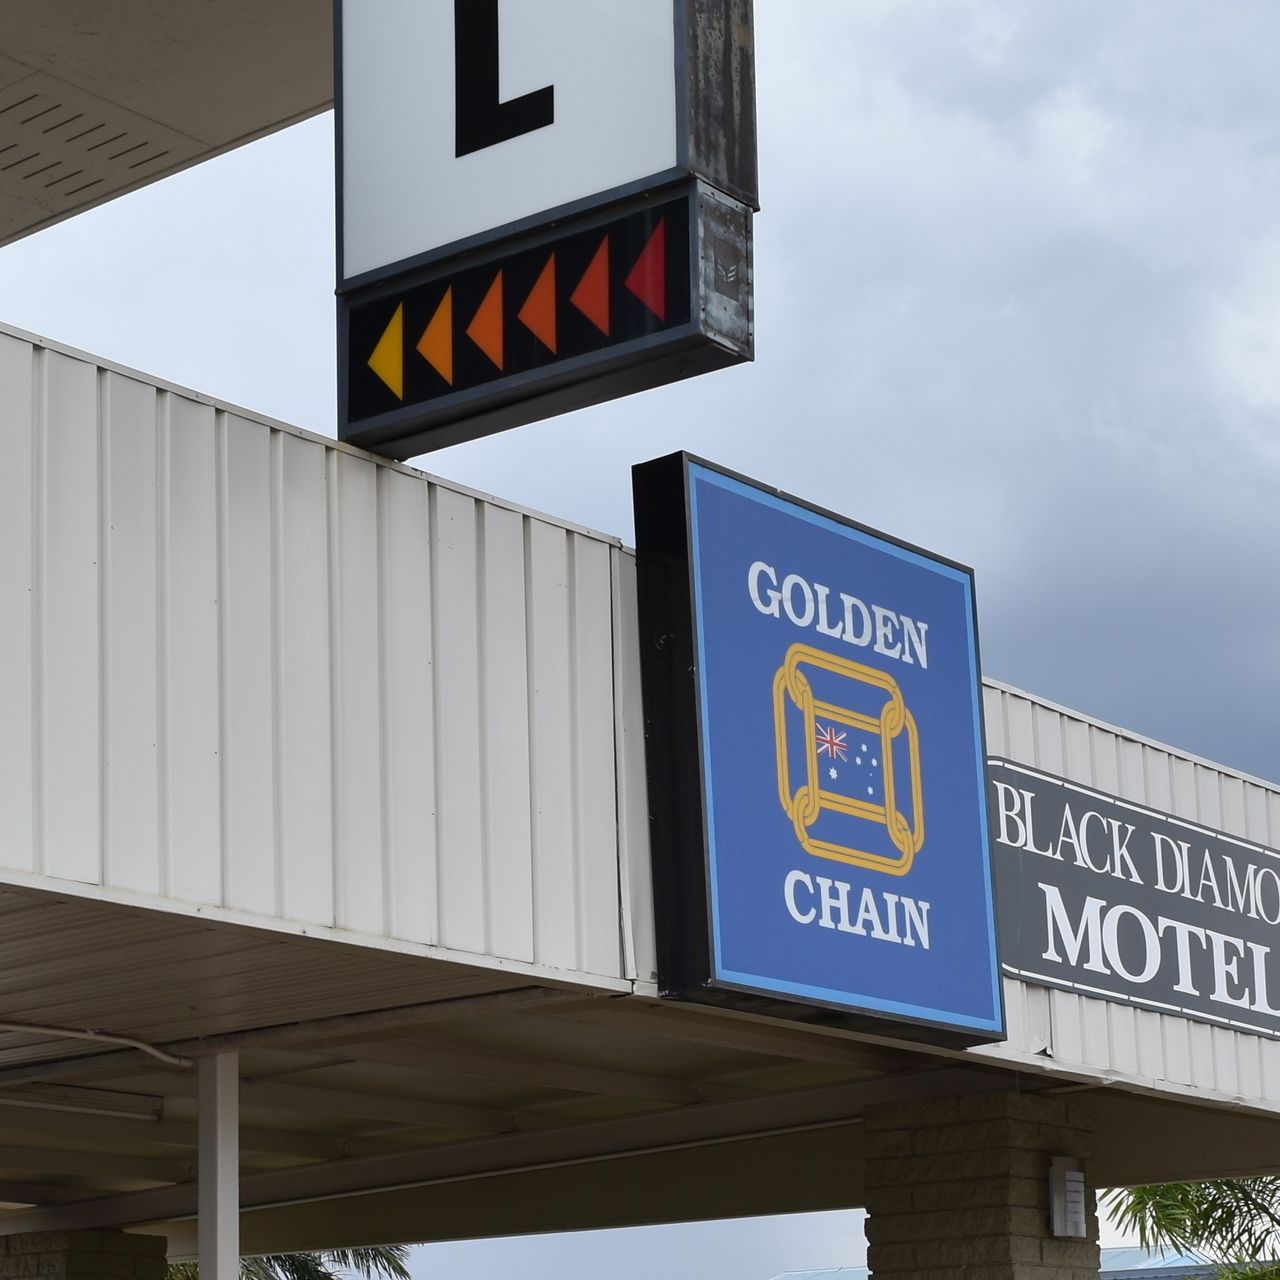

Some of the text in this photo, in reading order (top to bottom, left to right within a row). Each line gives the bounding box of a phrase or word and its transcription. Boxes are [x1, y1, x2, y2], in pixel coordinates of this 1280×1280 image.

[748, 561, 928, 669] GOLDEN
[993, 780, 1144, 885] BLACK
[784, 870, 930, 950] CHAIN
